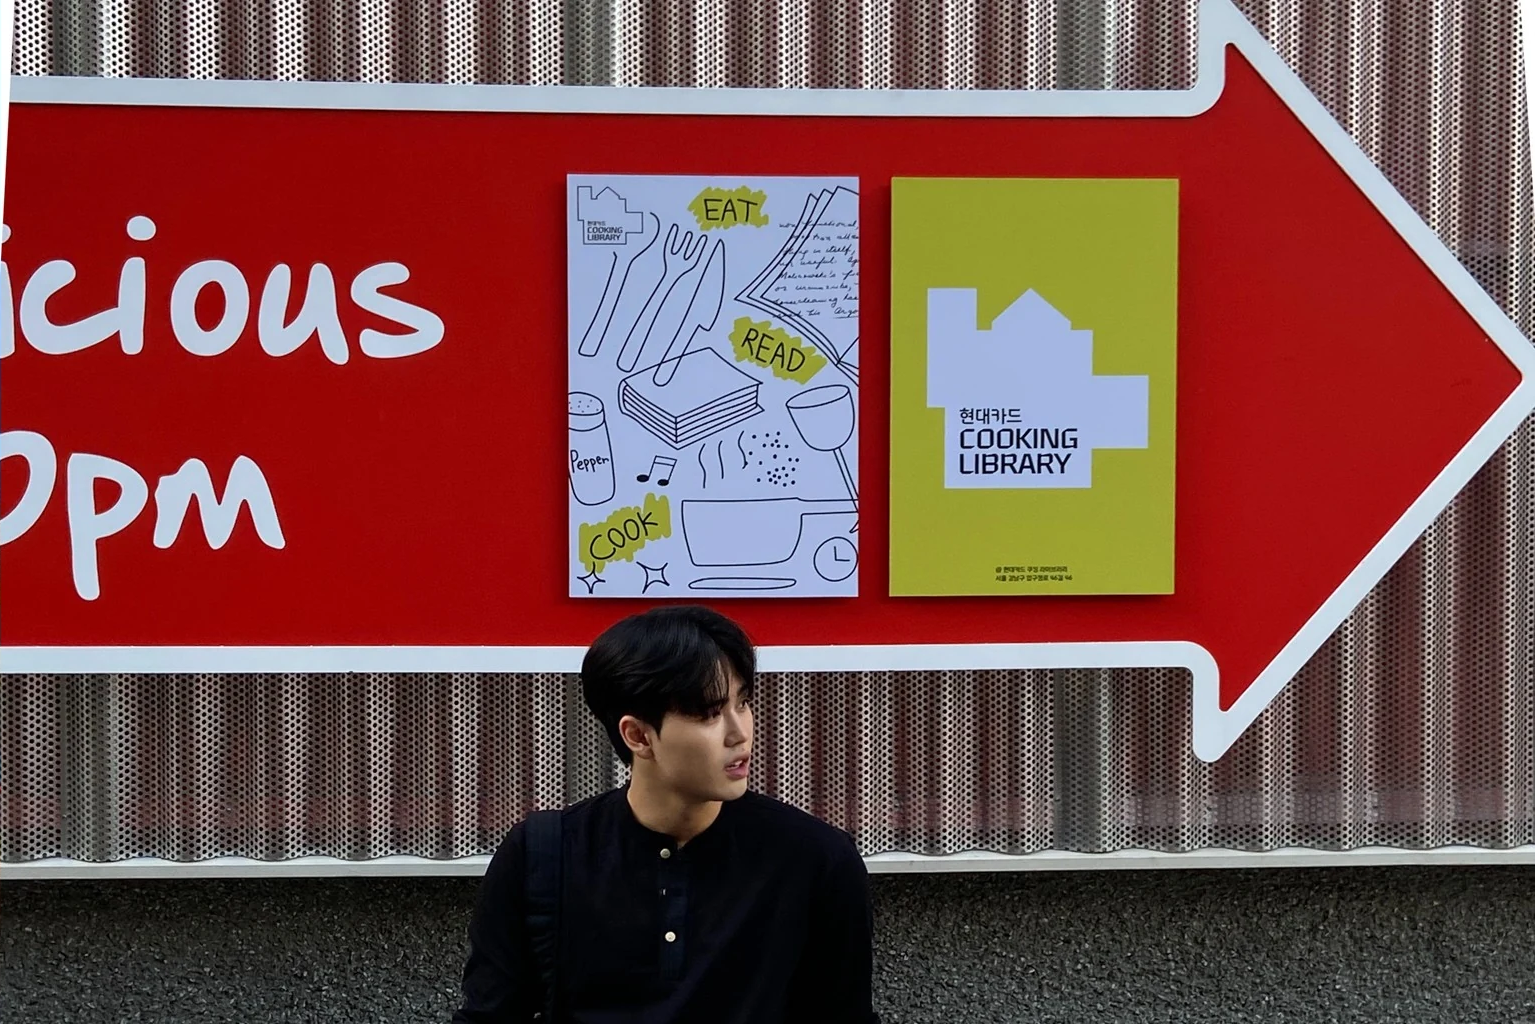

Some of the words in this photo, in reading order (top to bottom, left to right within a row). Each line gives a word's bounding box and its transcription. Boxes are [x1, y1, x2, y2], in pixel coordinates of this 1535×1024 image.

[703, 198, 758, 223] EAT
[587, 226, 623, 234] COOKING
[740, 328, 806, 373] READ
[959, 407, 1022, 425] 현대카드
[959, 428, 1078, 450] COOKING
[570, 449, 610, 474] Pepper
[959, 453, 1072, 475] LIBRARY
[589, 511, 659, 561] COOK
